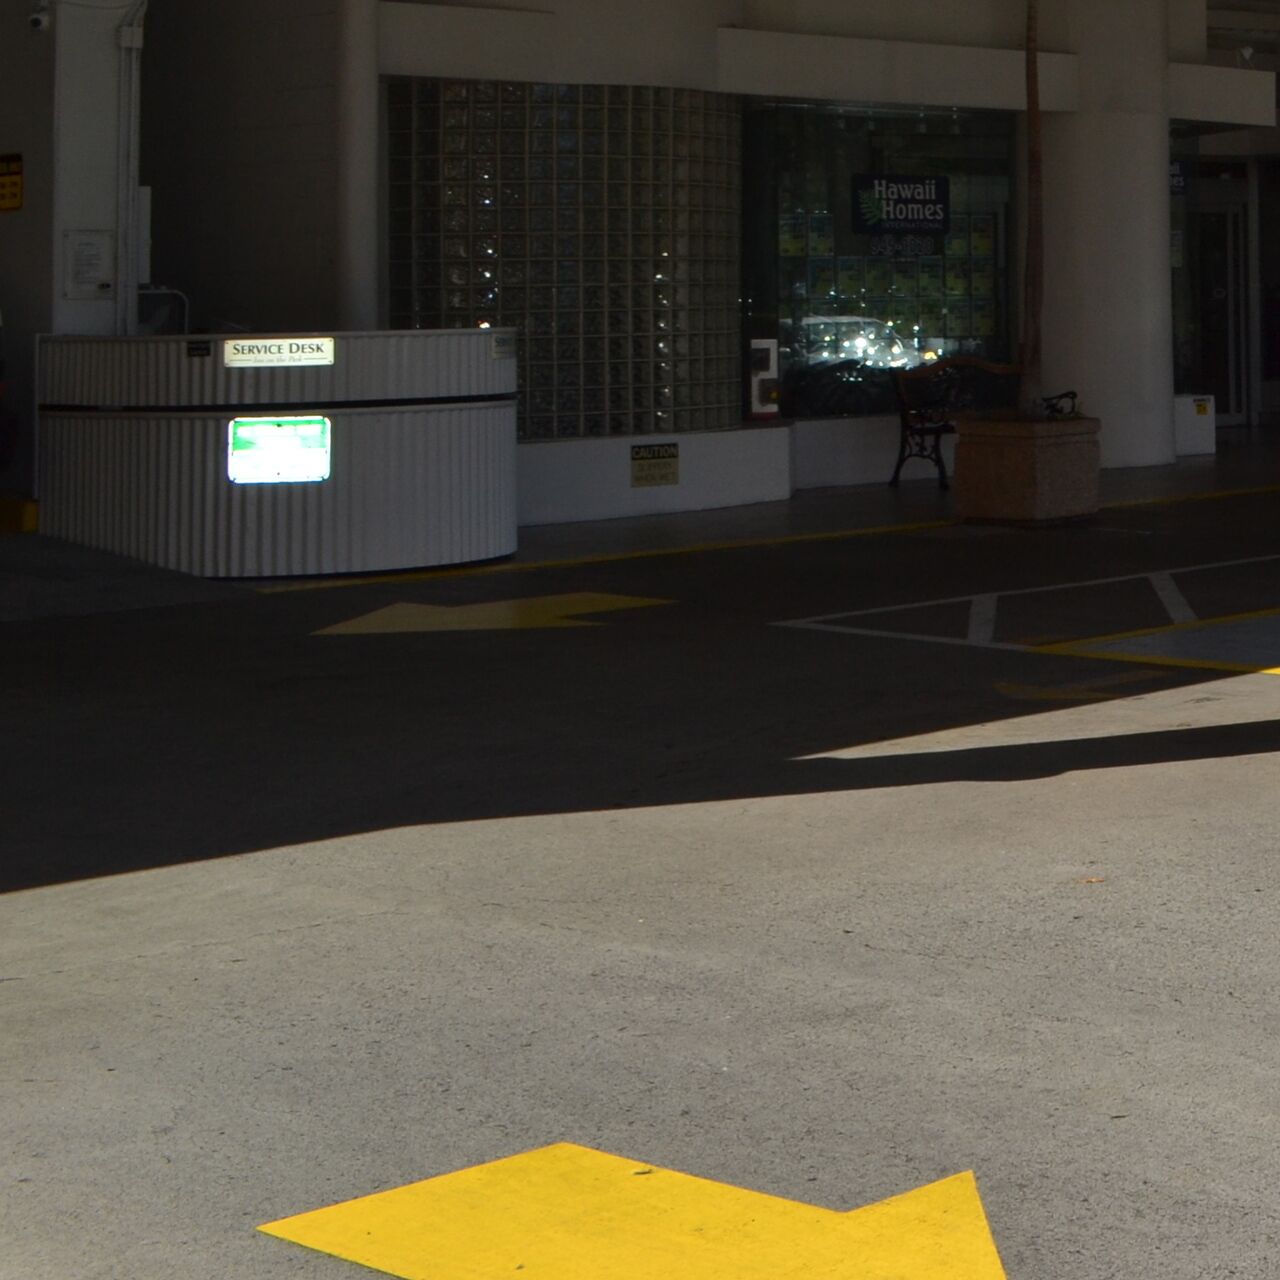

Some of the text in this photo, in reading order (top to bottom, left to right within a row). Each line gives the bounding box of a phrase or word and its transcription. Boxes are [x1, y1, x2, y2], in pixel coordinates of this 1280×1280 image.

[873, 179, 936, 200] Hawaii
[881, 199, 945, 221] Homes
[232, 341, 325, 355] SERVICE DESK
[633, 446, 678, 458] CAUTION
